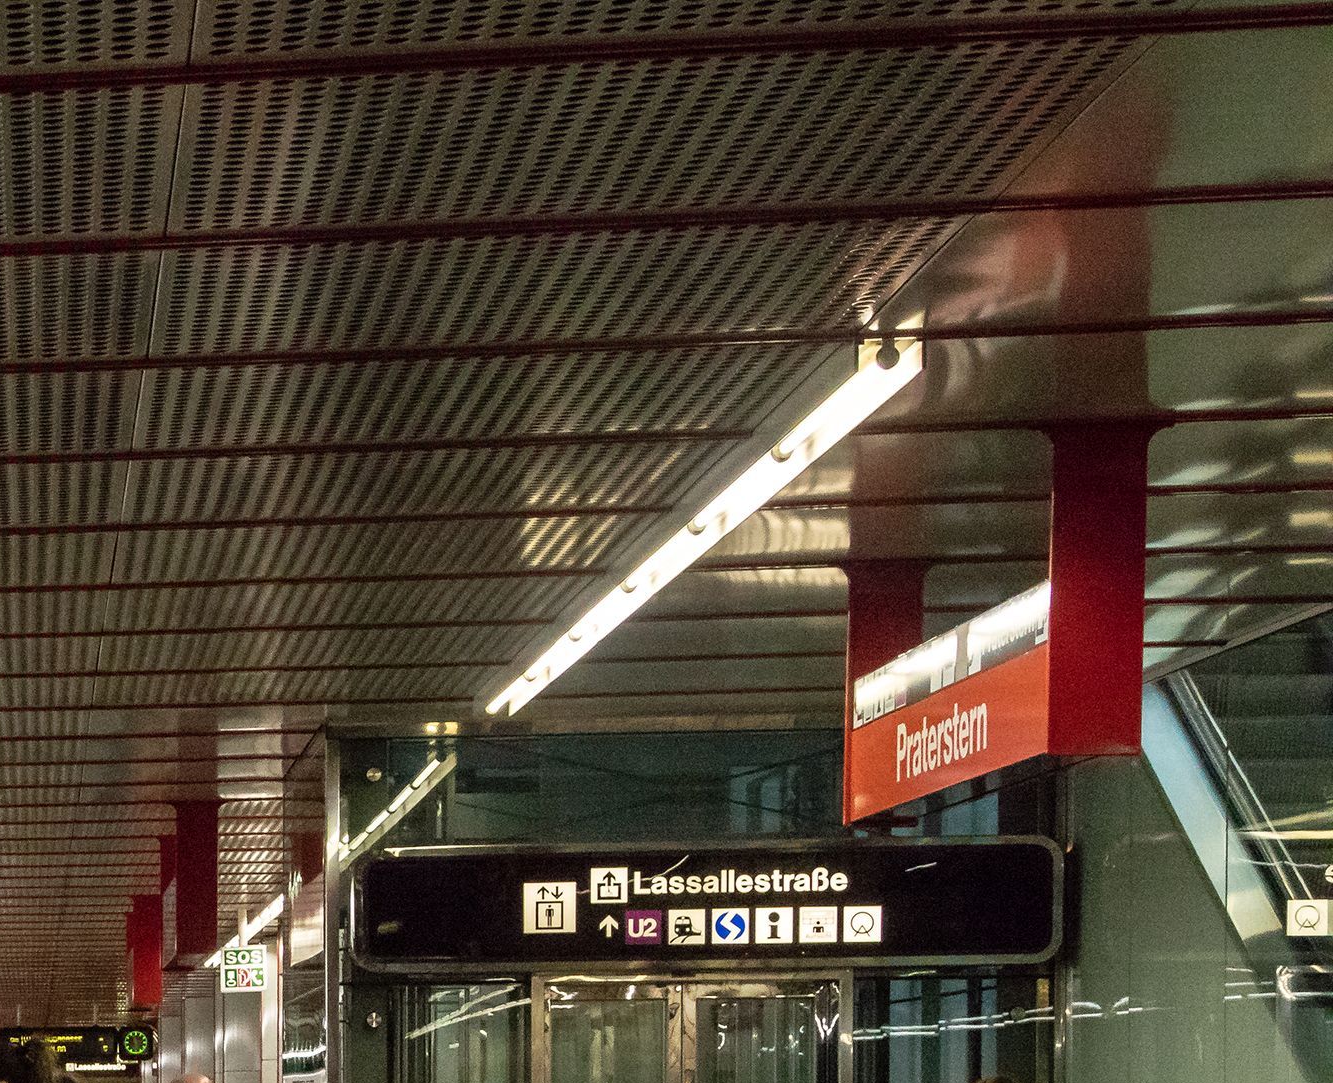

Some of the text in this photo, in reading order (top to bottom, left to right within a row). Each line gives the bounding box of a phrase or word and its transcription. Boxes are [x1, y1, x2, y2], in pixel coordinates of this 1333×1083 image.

[896, 702, 987, 783] Praterstern
[633, 867, 848, 895] Lassallestraße
[628, 918, 658, 938] U2
[225, 950, 263, 965] SOS
